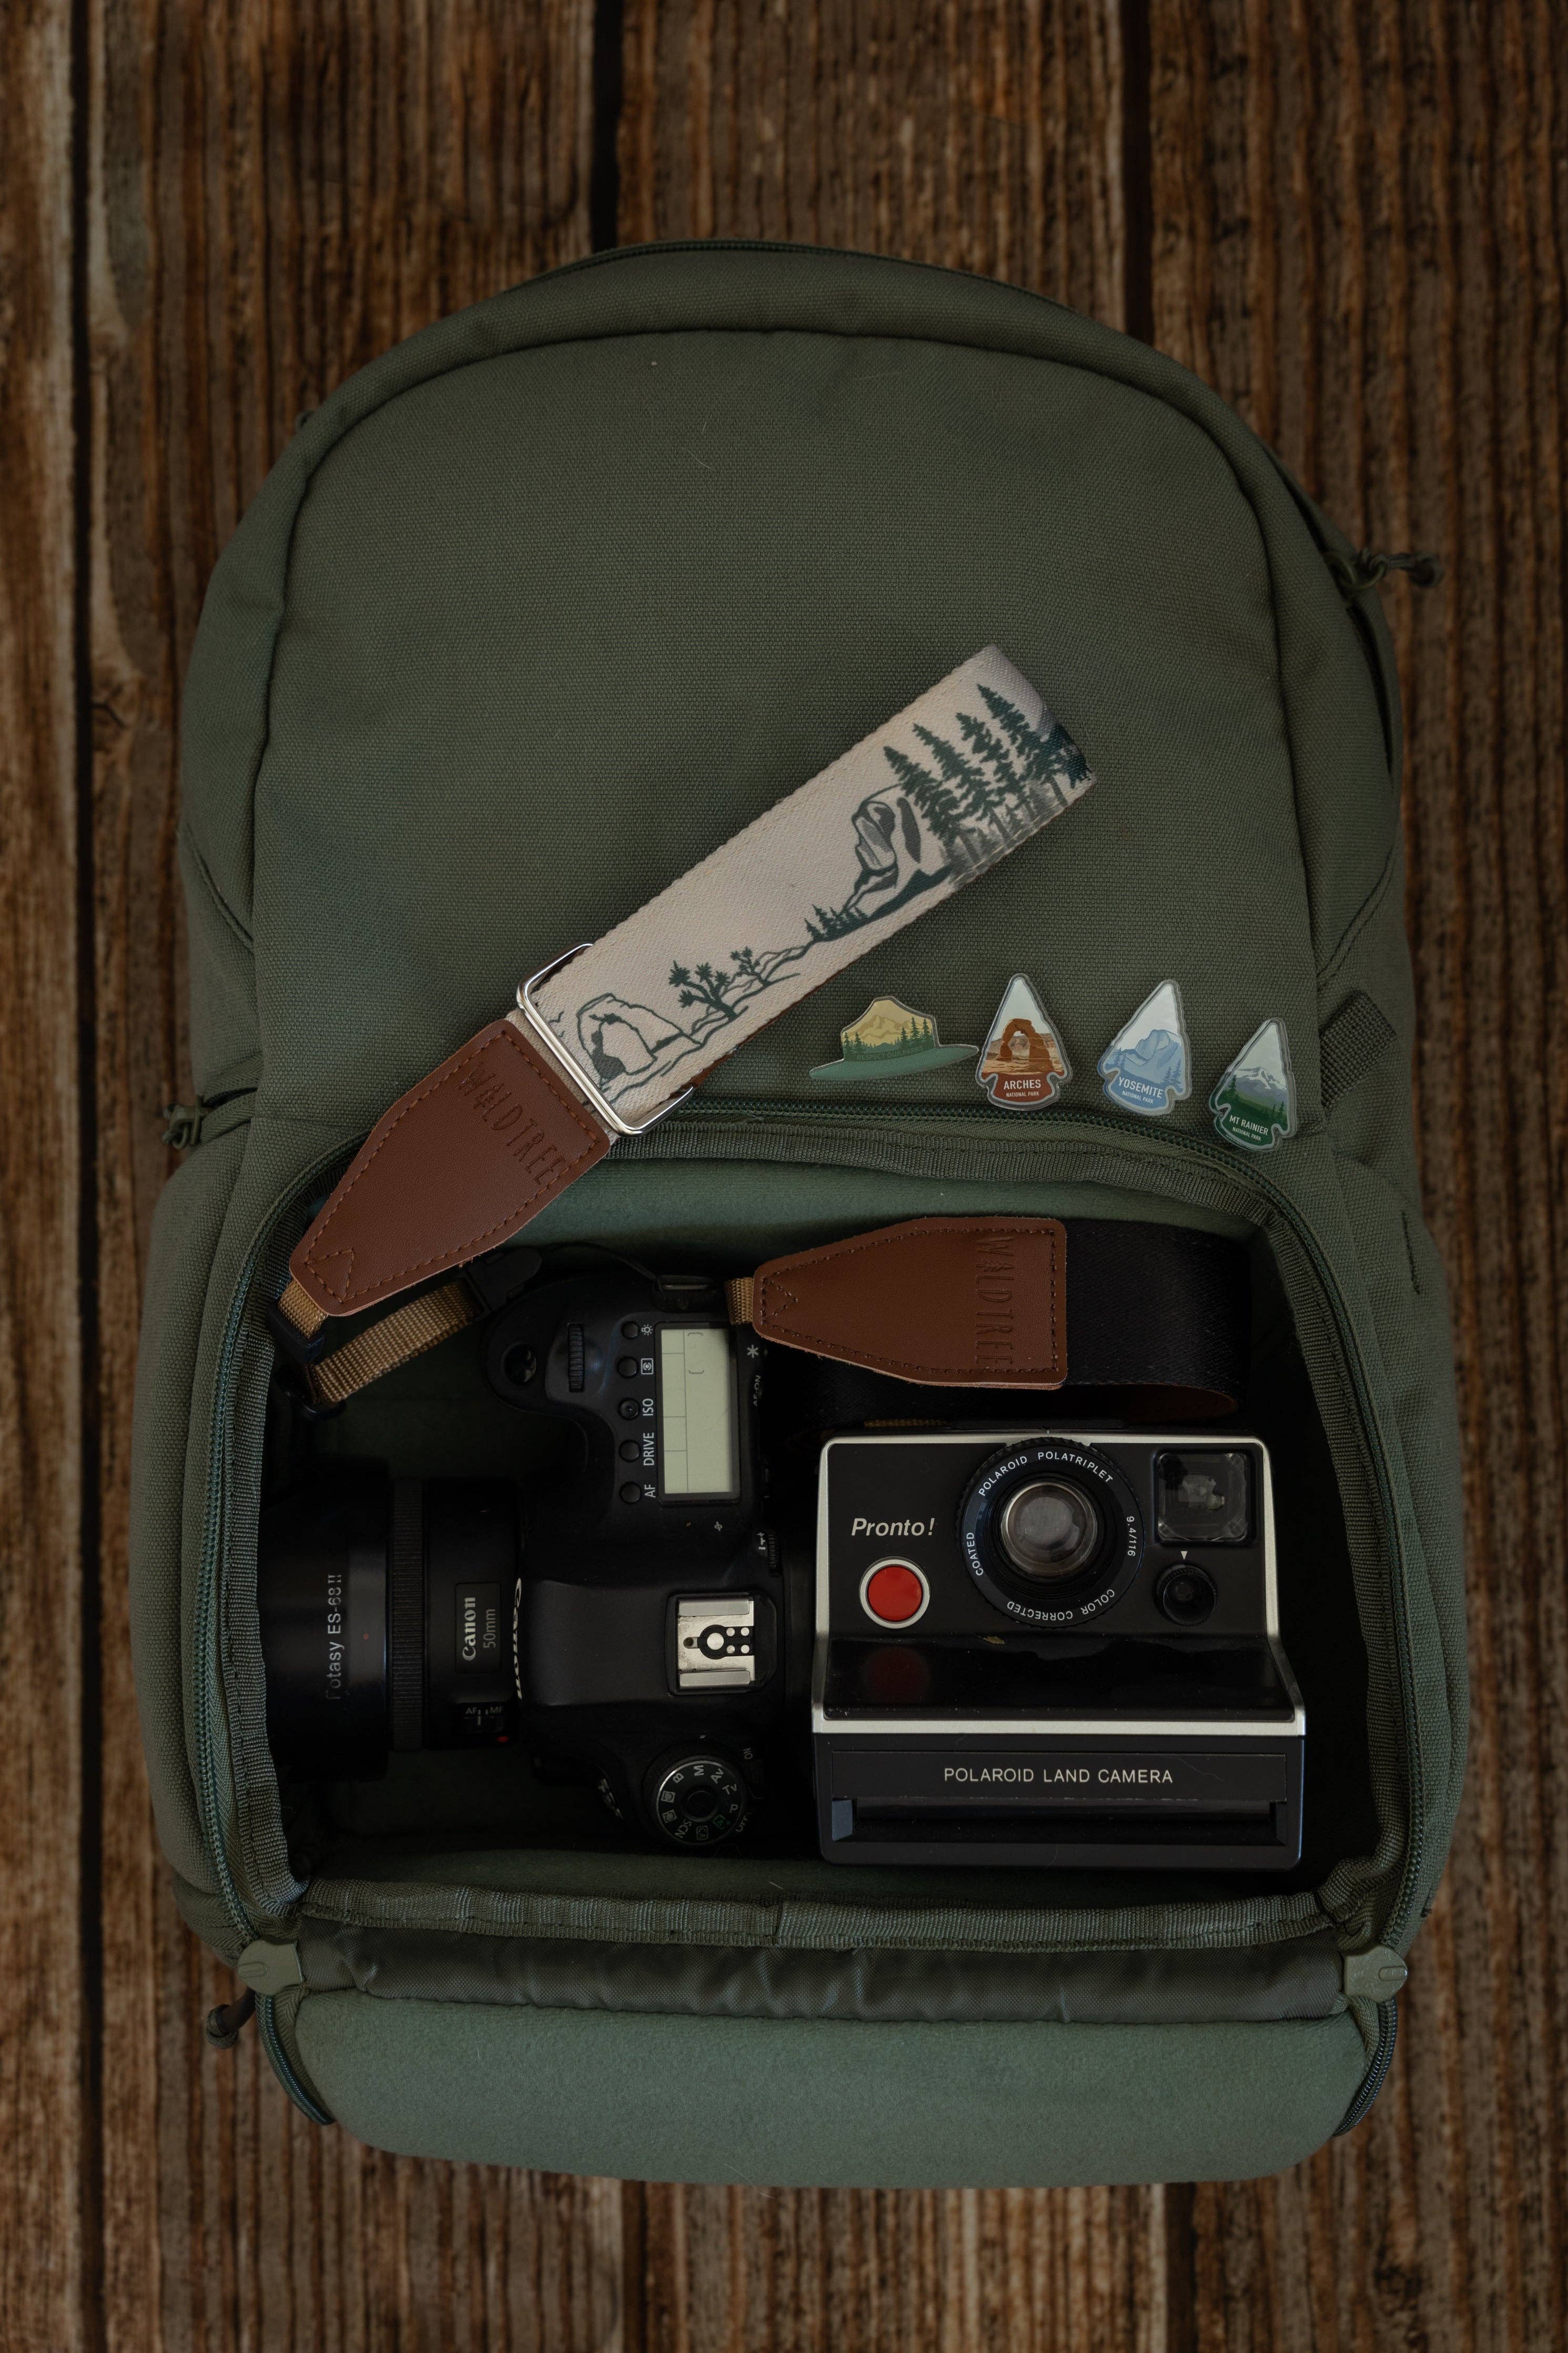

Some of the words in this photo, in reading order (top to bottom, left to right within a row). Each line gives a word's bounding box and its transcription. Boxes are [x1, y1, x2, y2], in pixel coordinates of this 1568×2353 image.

[1004, 1079, 1041, 1090] ARCHES
[1118, 1077, 1164, 1099] YOSEMITE
[1122, 1090, 1142, 1101] NATIONAL
[1142, 1096, 1154, 1104] PARK
[1229, 1115, 1240, 1125] MT
[1241, 1119, 1269, 1136] RAINIER
[1232, 1127, 1250, 1137] NATIONAL
[752, 1374, 762, 1407] AF-ON
[642, 1397, 654, 1416] ISO
[643, 1432, 655, 1466] DRIVE
[978, 1455, 1028, 1496] POLAROID
[1037, 1451, 1114, 1483] POLATRIPLET
[644, 1483, 656, 1499] AF
[851, 1517, 935, 1537] Pronto!
[1126, 1515, 1137, 1557] 9.4/116
[966, 1532, 984, 1577] COATED
[1006, 1601, 1074, 1622] CORRECTED
[1080, 1588, 1115, 1616] COLOR
[461, 1596, 477, 1662] Canon
[483, 1608, 497, 1649] 50mm
[672, 1772, 684, 1784] B
[693, 1764, 705, 1776] M
[711, 1768, 724, 1784] Av
[944, 1767, 1034, 1783] POLAROID
[1043, 1768, 1090, 1783] LAND
[1097, 1768, 1174, 1784] CAMERA
[722, 1784, 737, 1795] Tv
[729, 1803, 739, 1814] P
[674, 1818, 692, 1839] SCN
